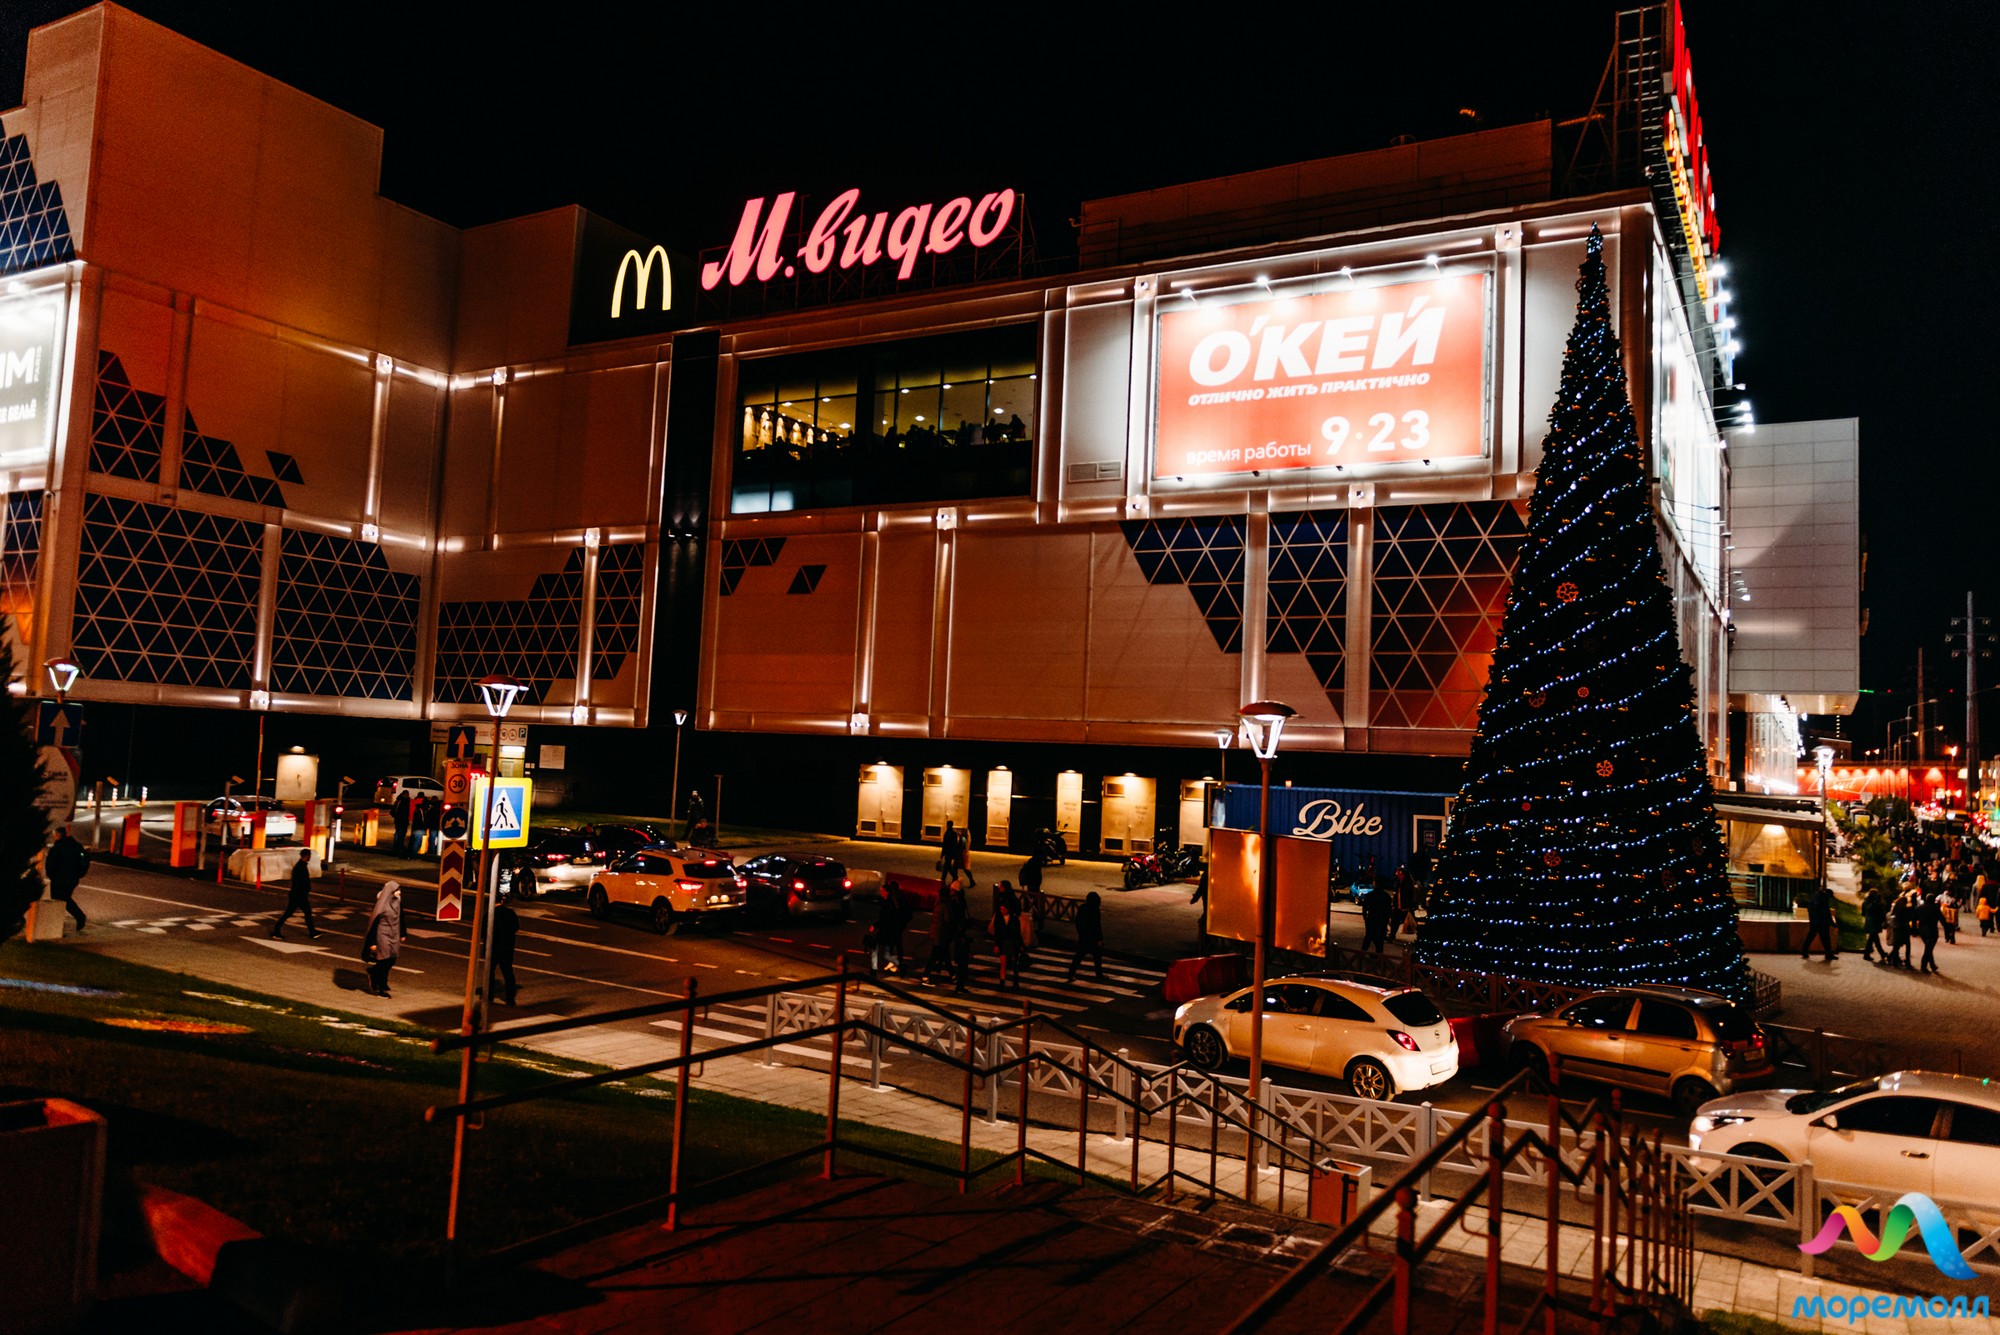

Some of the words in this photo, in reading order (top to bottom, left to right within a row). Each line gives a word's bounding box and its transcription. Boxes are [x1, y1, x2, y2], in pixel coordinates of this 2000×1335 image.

[1188, 387, 1264, 406] ОТЛИЧНО
[1266, 382, 1318, 399] ЖИТЬ
[1321, 372, 1430, 394] ПРАКТИЧНО
[1186, 448, 1241, 466] время
[1244, 441, 1311, 463] работы
[452, 779, 464, 788] 30
[1292, 799, 1383, 839] Bike
